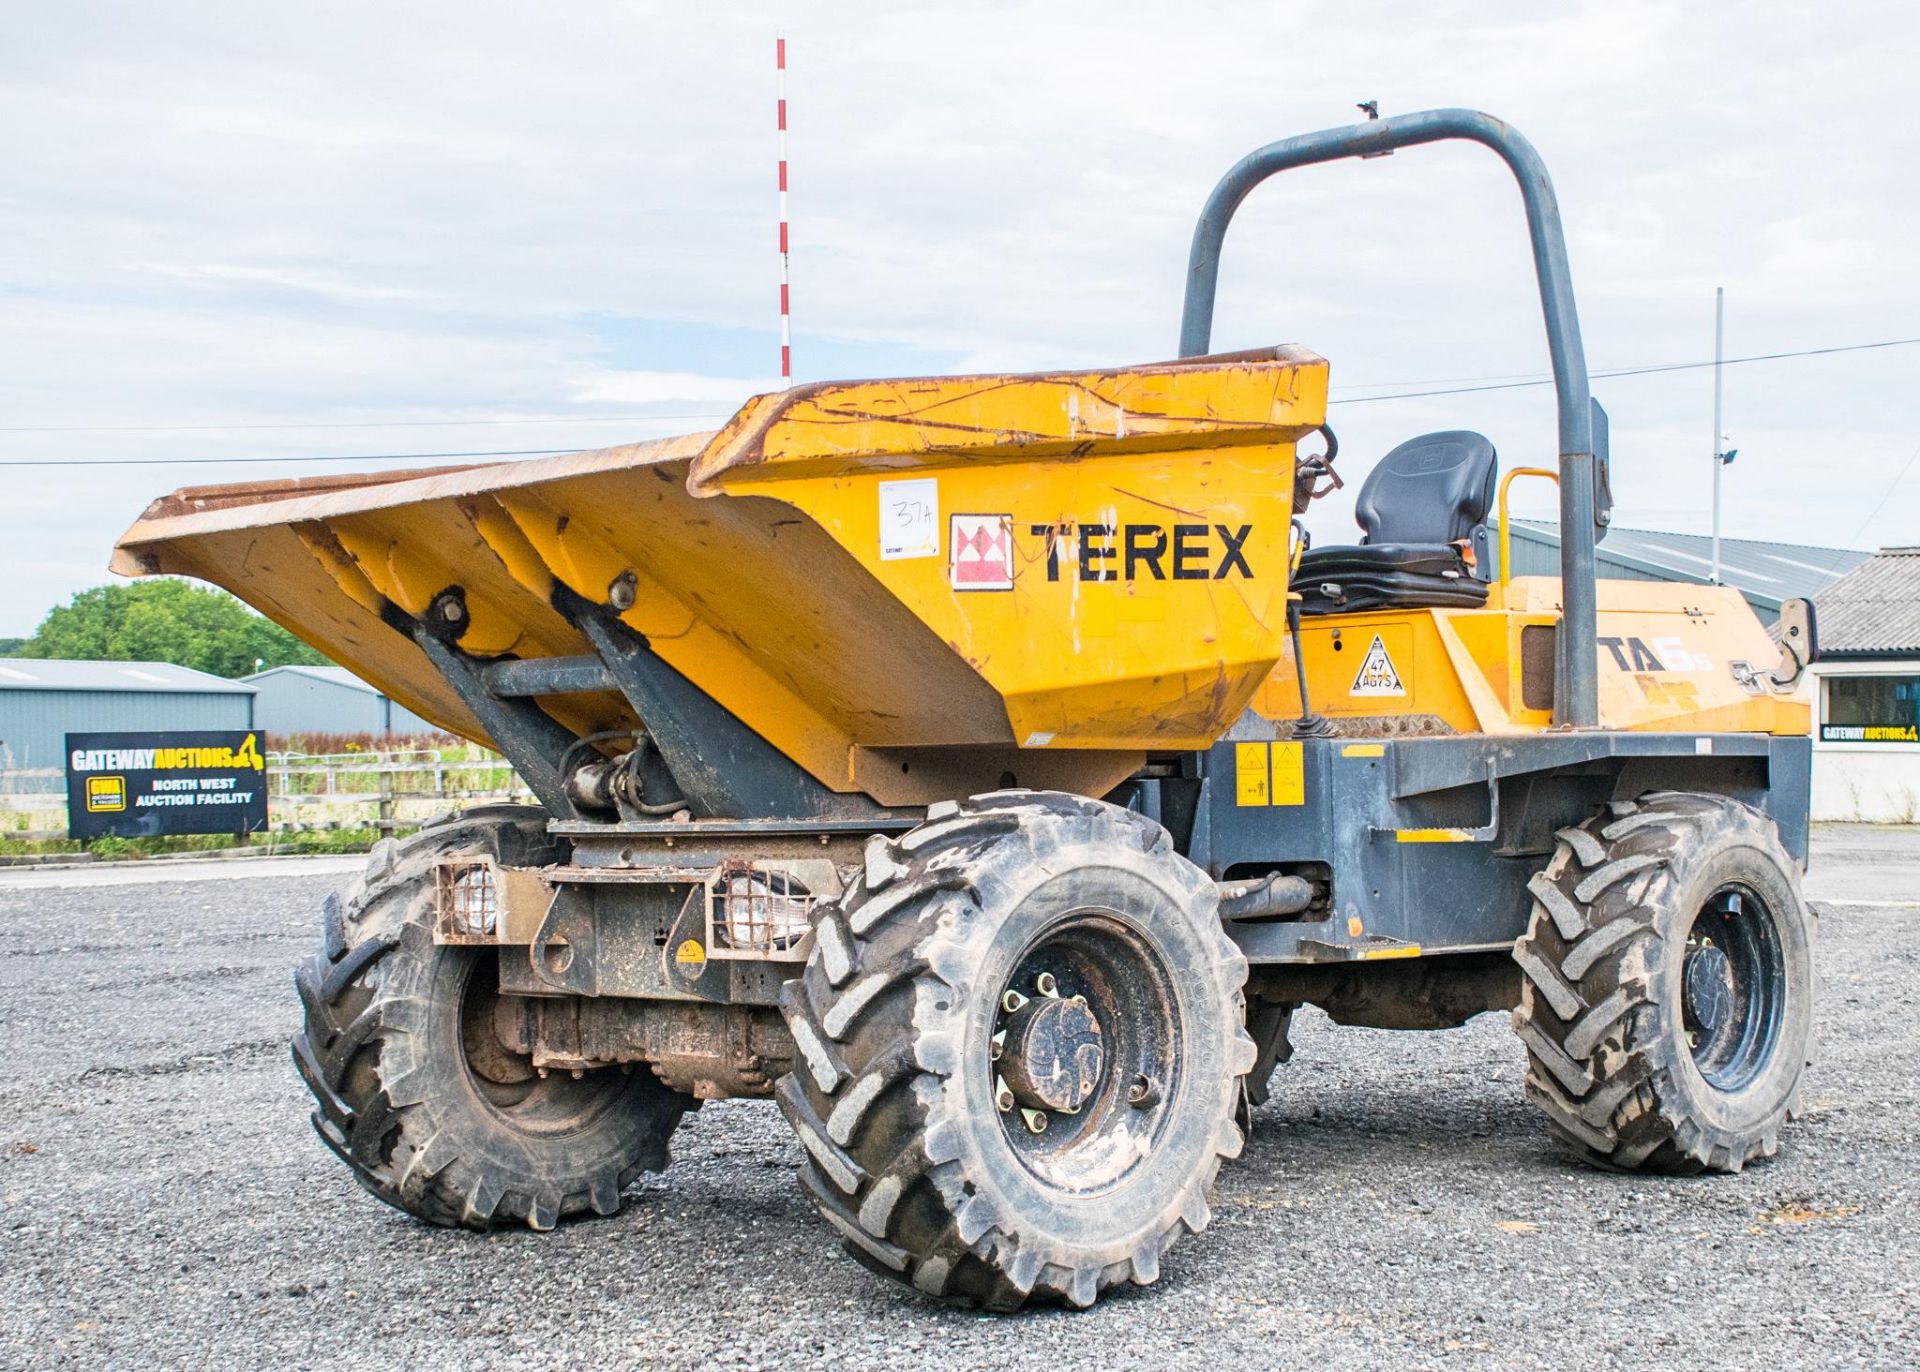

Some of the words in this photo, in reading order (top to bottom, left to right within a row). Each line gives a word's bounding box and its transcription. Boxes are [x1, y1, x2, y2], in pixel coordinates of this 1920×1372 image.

[1031, 524, 1254, 582] TEREX
[1371, 659, 1385, 672] 47
[152, 779, 198, 791] NORTH
[200, 778, 237, 790] WEST
[135, 795, 195, 807] AUCTION
[197, 793, 253, 805] FACILITY
